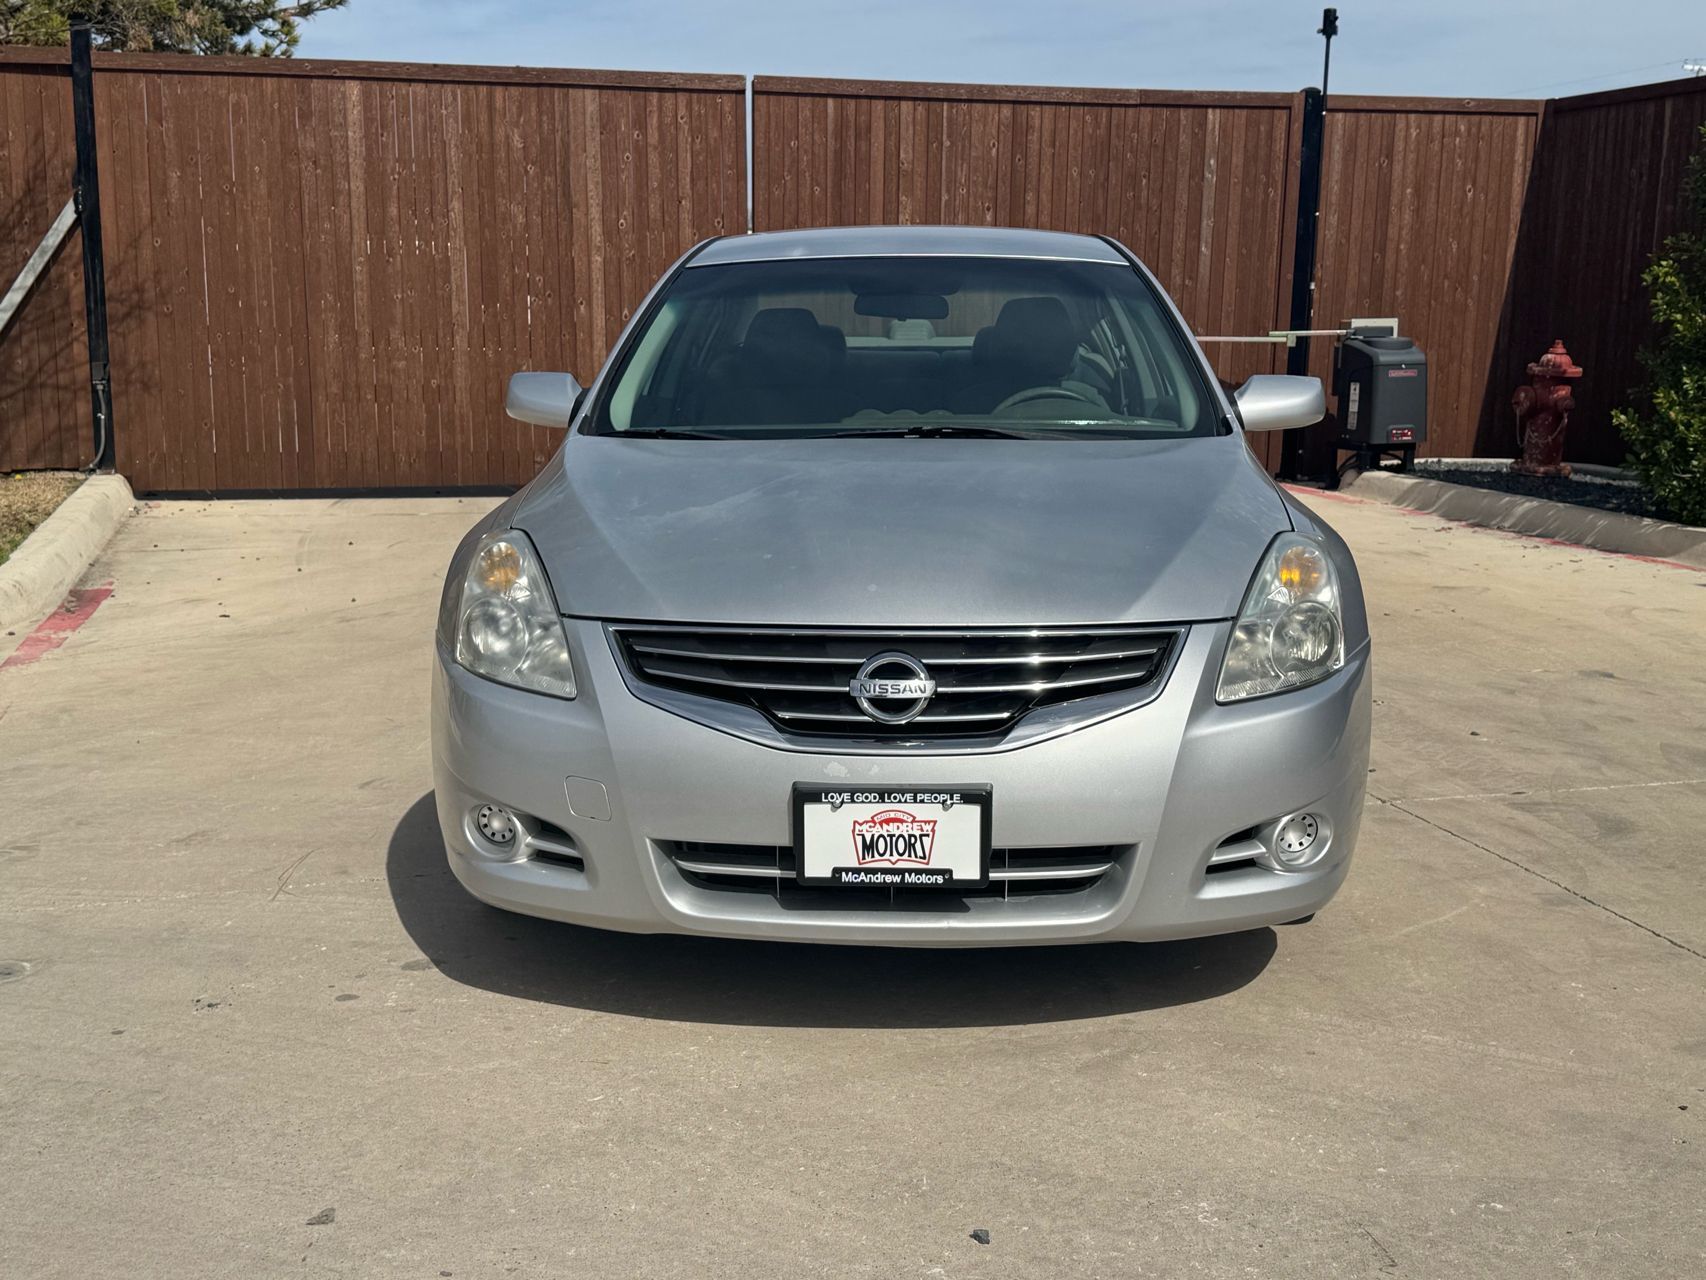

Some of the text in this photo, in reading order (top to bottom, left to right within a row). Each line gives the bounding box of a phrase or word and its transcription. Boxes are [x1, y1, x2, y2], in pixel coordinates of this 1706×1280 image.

[859, 683, 927, 694] NISSAN
[821, 792, 964, 804] LOVE GOD. LOVE PEOPLE.
[856, 833, 931, 861] MOTORS
[841, 871, 944, 884] McAndrew Motors
